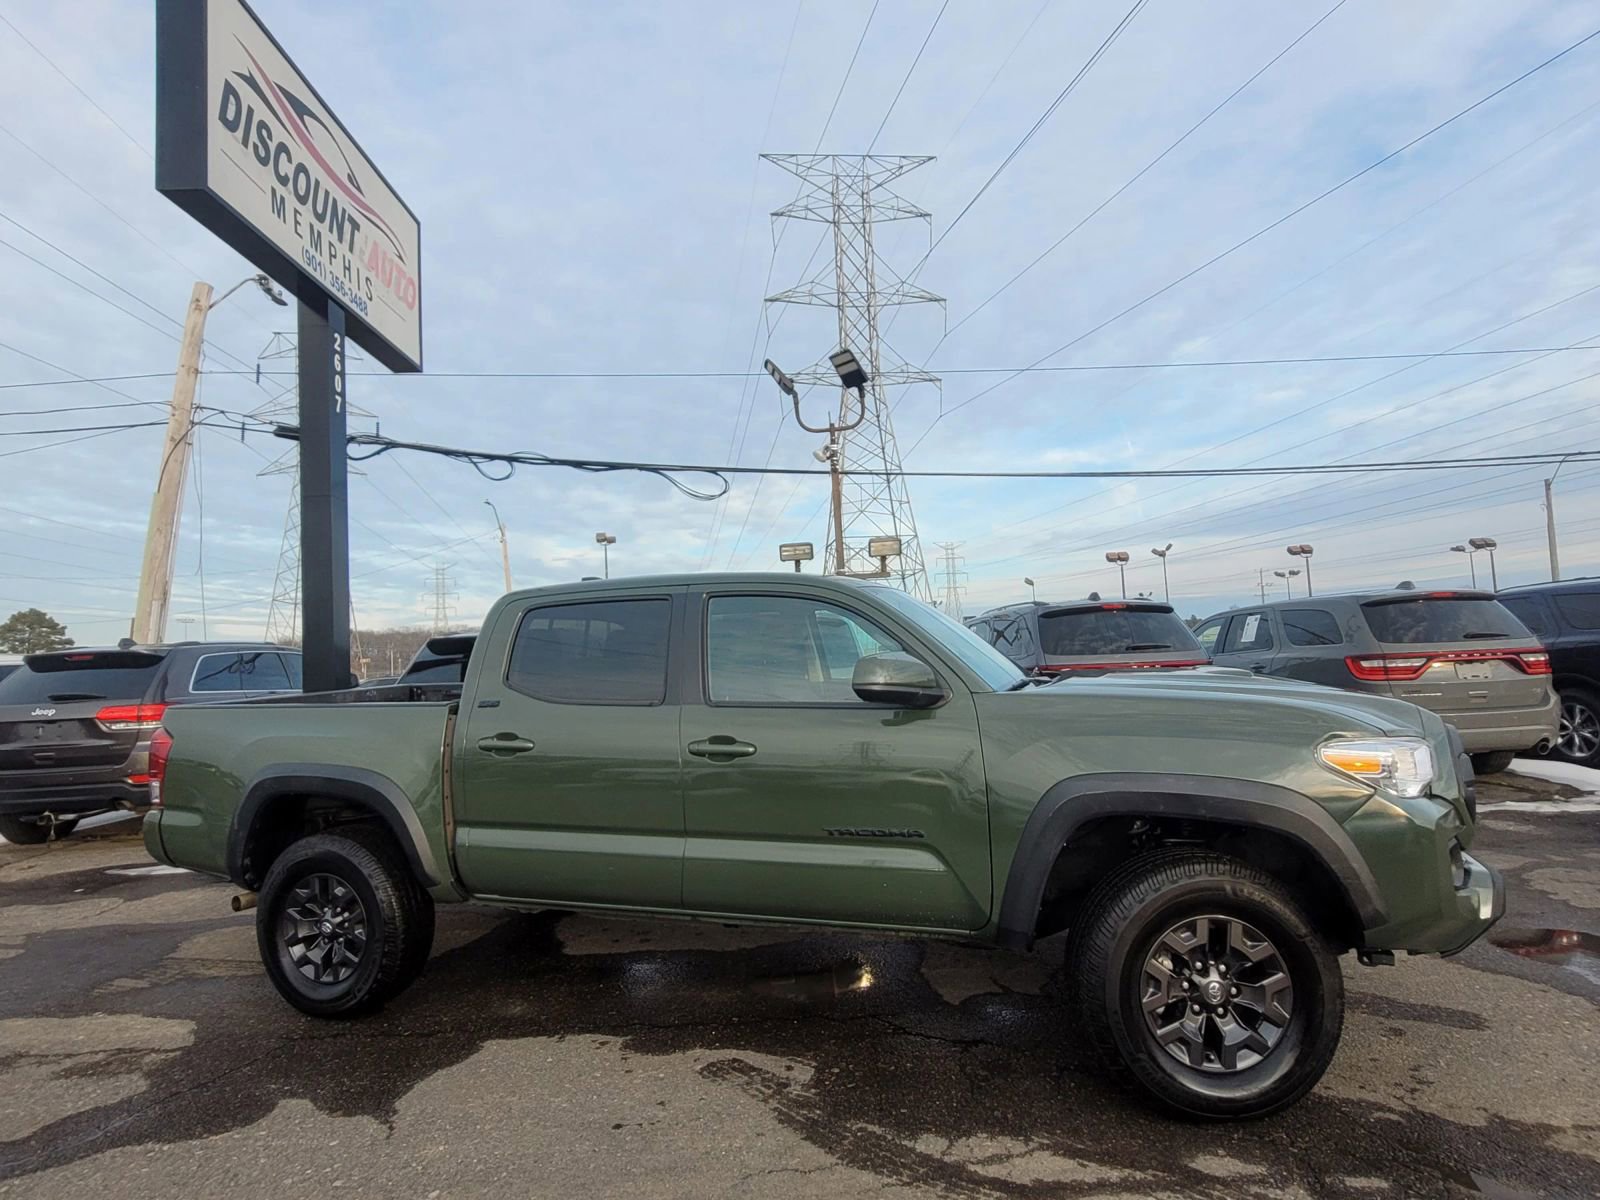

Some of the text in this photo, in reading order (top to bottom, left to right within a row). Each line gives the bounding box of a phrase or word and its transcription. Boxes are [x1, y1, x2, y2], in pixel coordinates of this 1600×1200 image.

[218, 77, 417, 311] DISCOUNT AUTO
[271, 184, 373, 302] MEMPHIS
[301, 245, 369, 317] (901) 356-3488
[334, 332, 342, 413] 2607
[31, 707, 56, 717] Jeep
[822, 827, 925, 839] TACOMA
